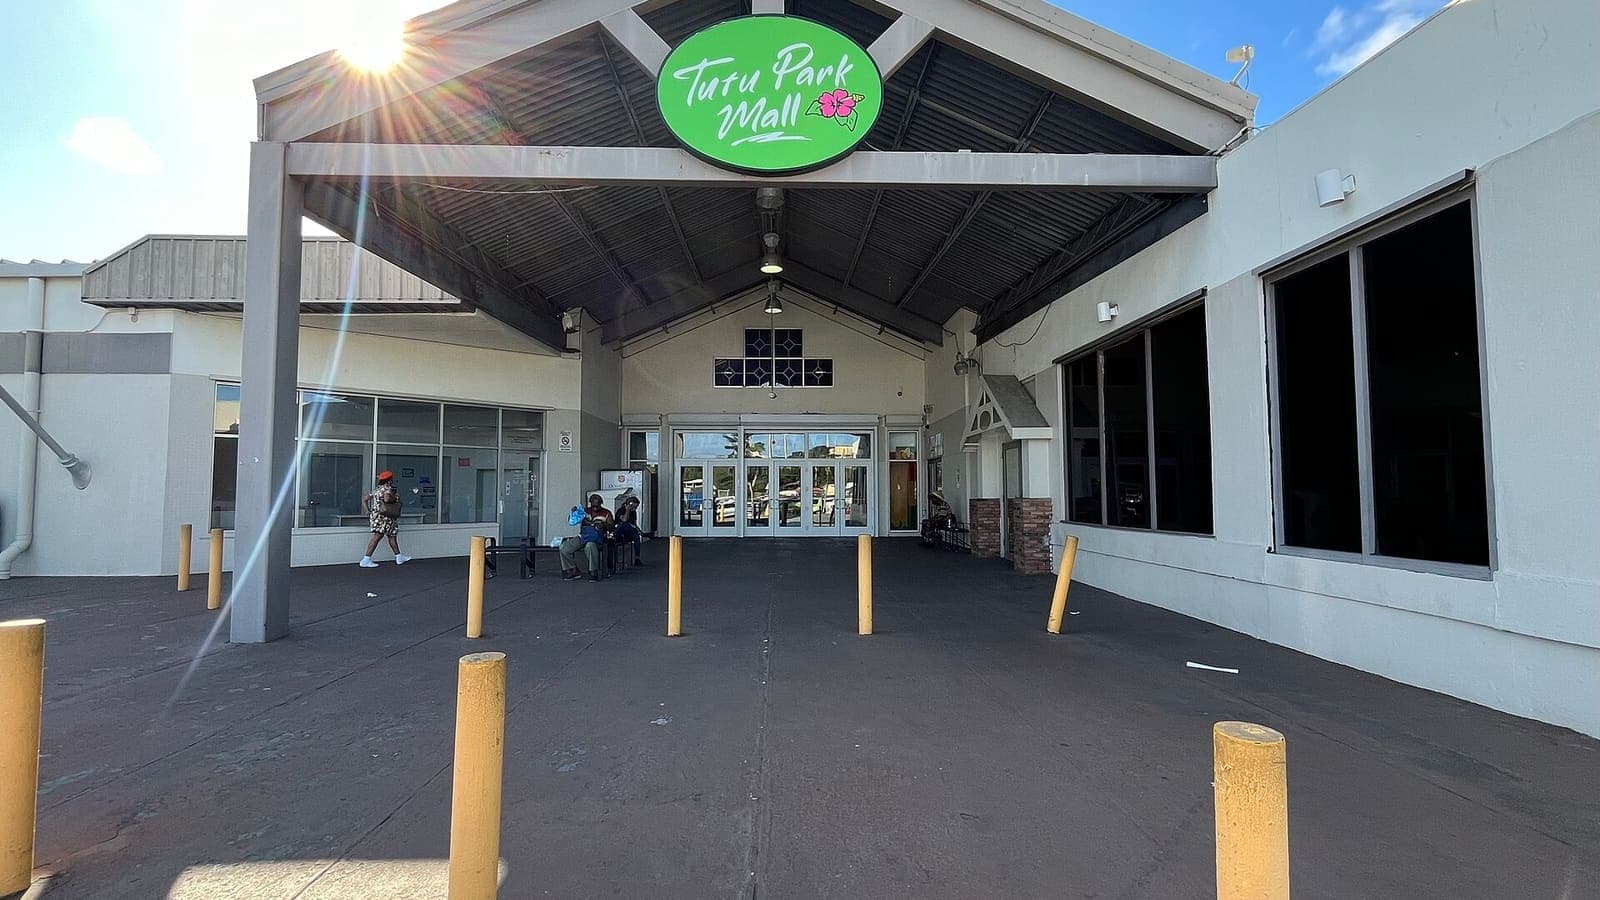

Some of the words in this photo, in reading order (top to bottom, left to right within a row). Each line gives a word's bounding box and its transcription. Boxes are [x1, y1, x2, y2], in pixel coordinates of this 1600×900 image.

[673, 57, 760, 107] Tutu
[772, 42, 854, 90] Park
[717, 93, 801, 140] Mall
